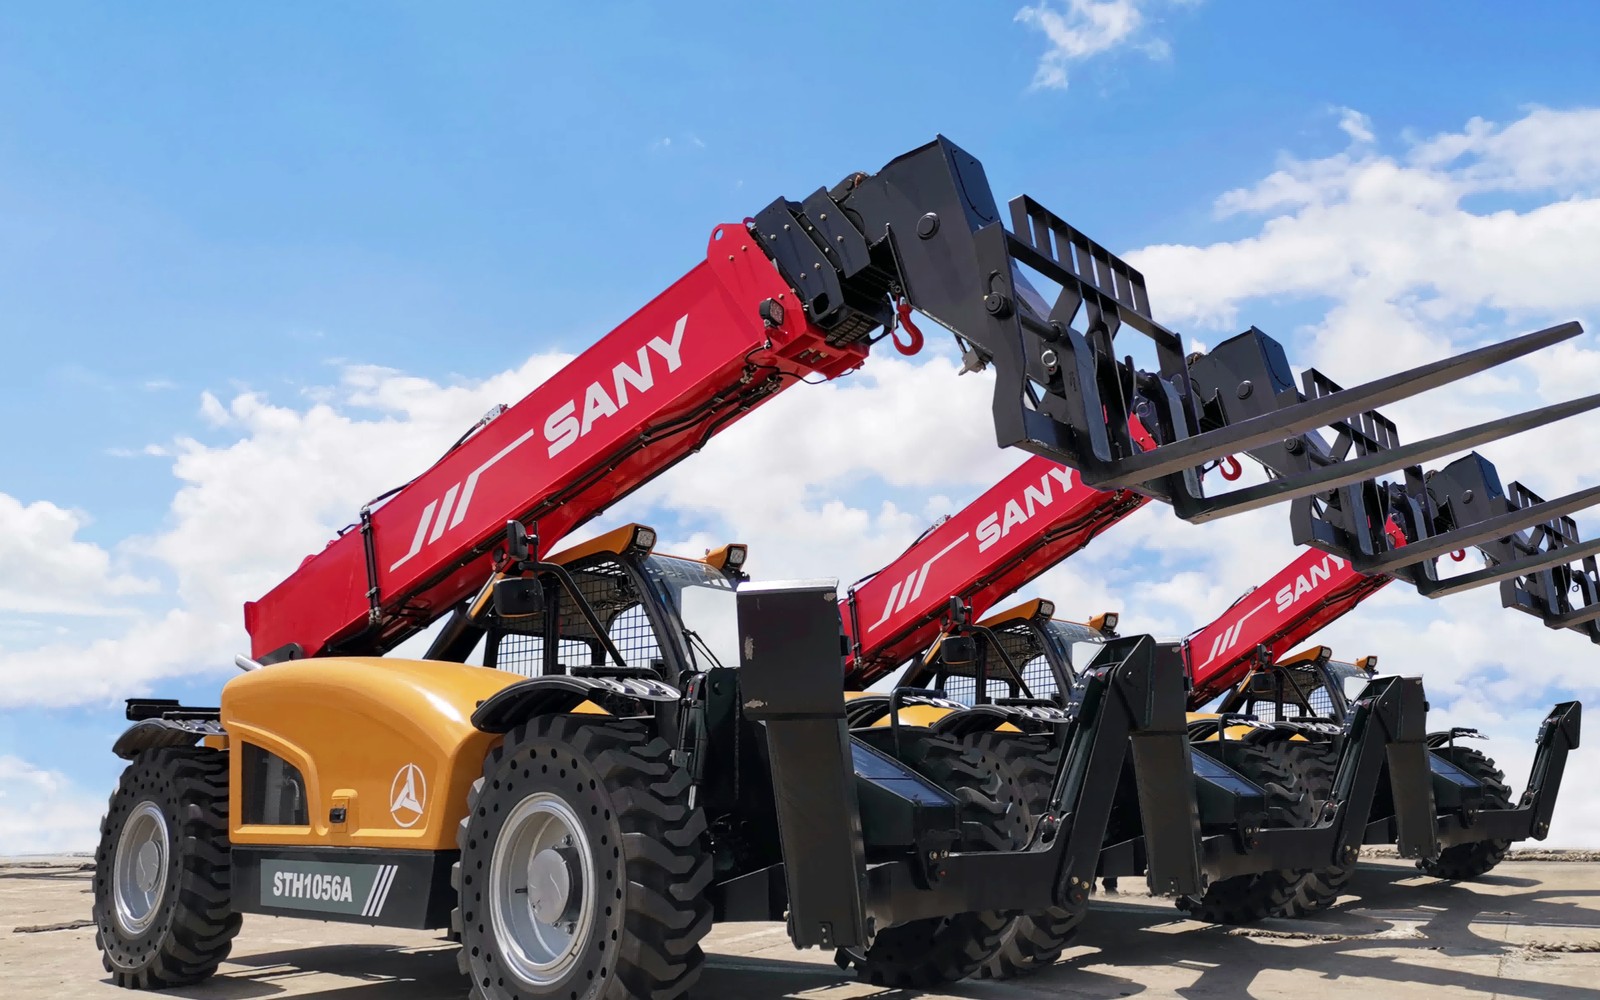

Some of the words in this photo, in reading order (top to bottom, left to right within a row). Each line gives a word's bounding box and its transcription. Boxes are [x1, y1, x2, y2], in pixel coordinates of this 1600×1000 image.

[543, 313, 689, 459] SANY
[975, 466, 1073, 554] SANY
[272, 871, 353, 902] STH1056A
